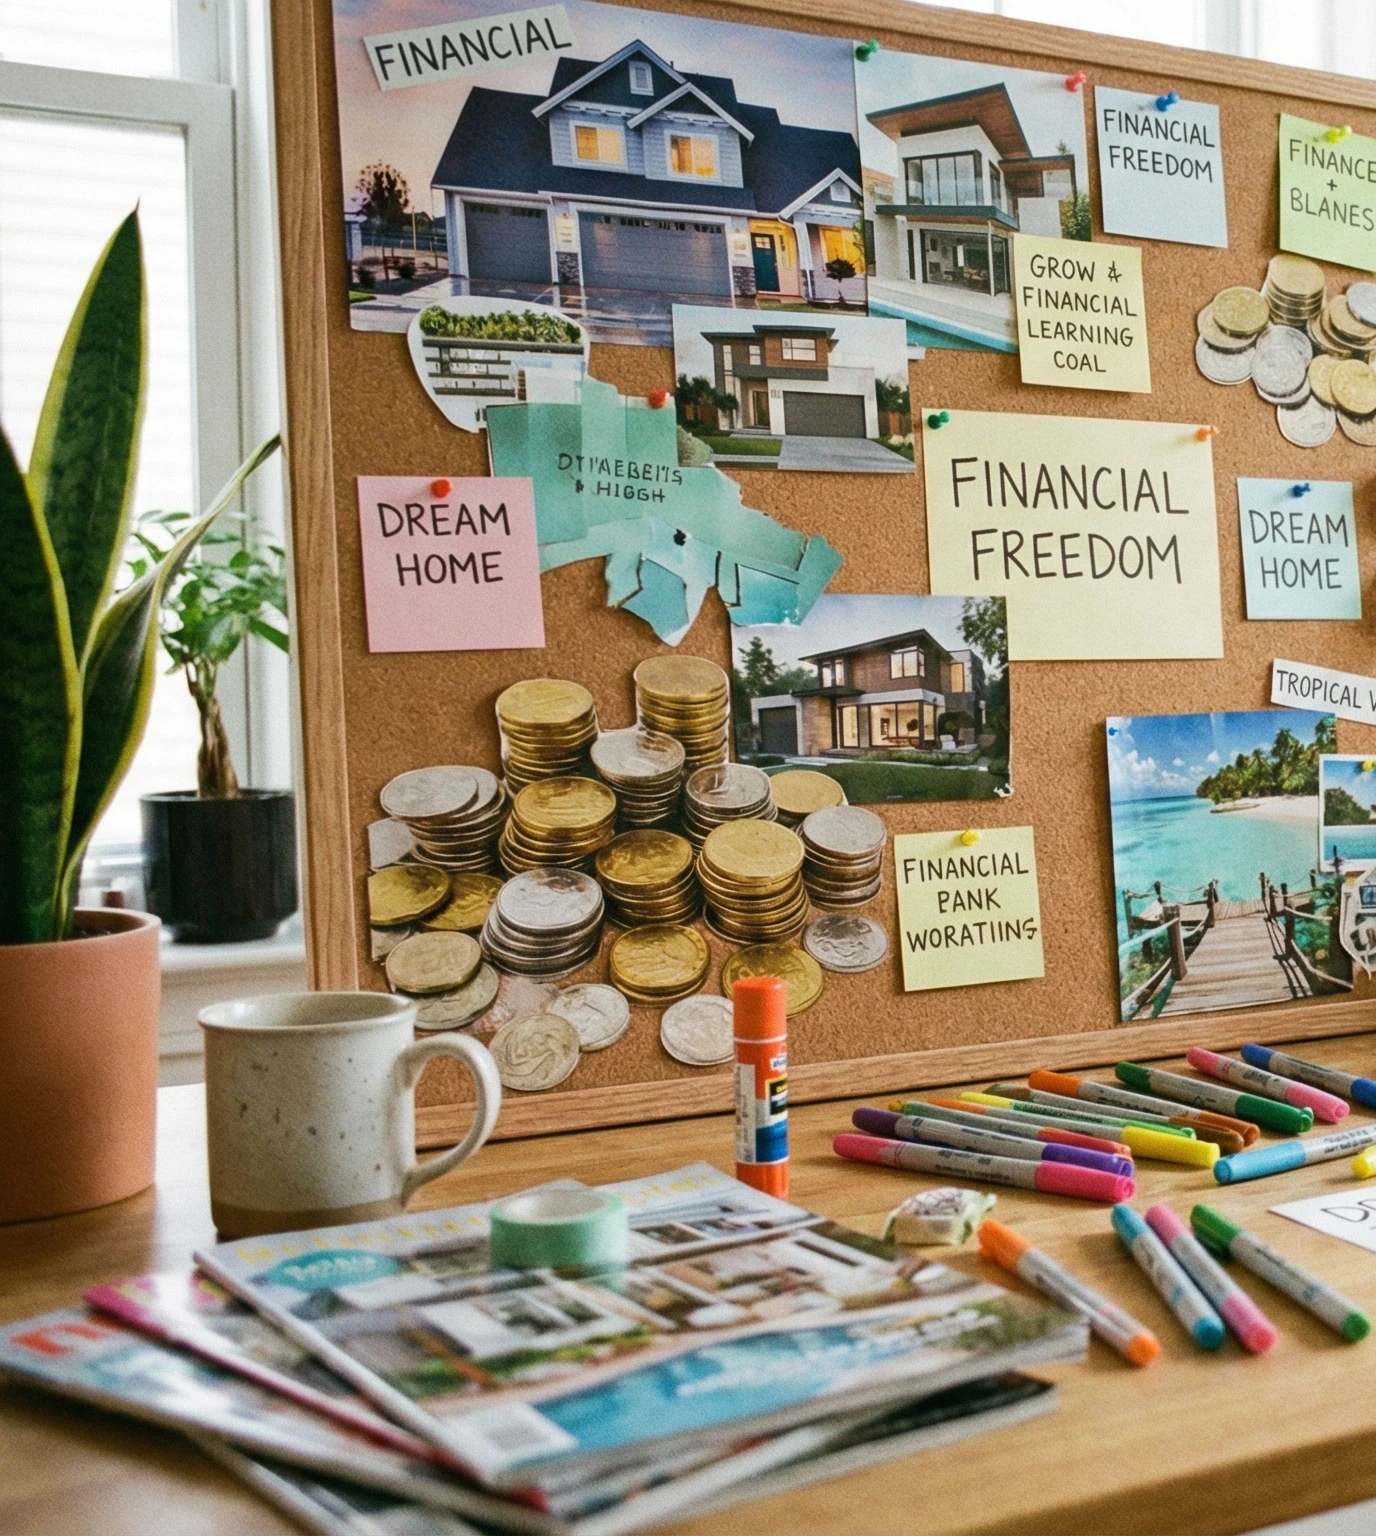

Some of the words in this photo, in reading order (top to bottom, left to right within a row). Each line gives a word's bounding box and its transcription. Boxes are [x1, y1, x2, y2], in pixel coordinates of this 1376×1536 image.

[375, 18, 573, 81] FINANCIAL
[1103, 109, 1215, 148] FINANCIAL
[1109, 145, 1213, 183] FREEDOM
[1326, 179, 1338, 191] +
[1290, 187, 1375, 231] BLANES
[1030, 254, 1095, 282] GROW
[1023, 286, 1137, 317] FINANCIAL
[1027, 318, 1133, 347] LEARNING
[1053, 350, 1107, 373] COAL
[951, 456, 1190, 515] FINANCIAL
[376, 502, 511, 538] DREAM
[1248, 509, 1349, 548] DREAM
[395, 550, 504, 587] HOME
[971, 528, 1183, 585] FREEDOM
[1260, 556, 1343, 590] HOME
[1276, 669, 1362, 709] TROPICAL
[903, 852, 1029, 884] FINANCIAL
